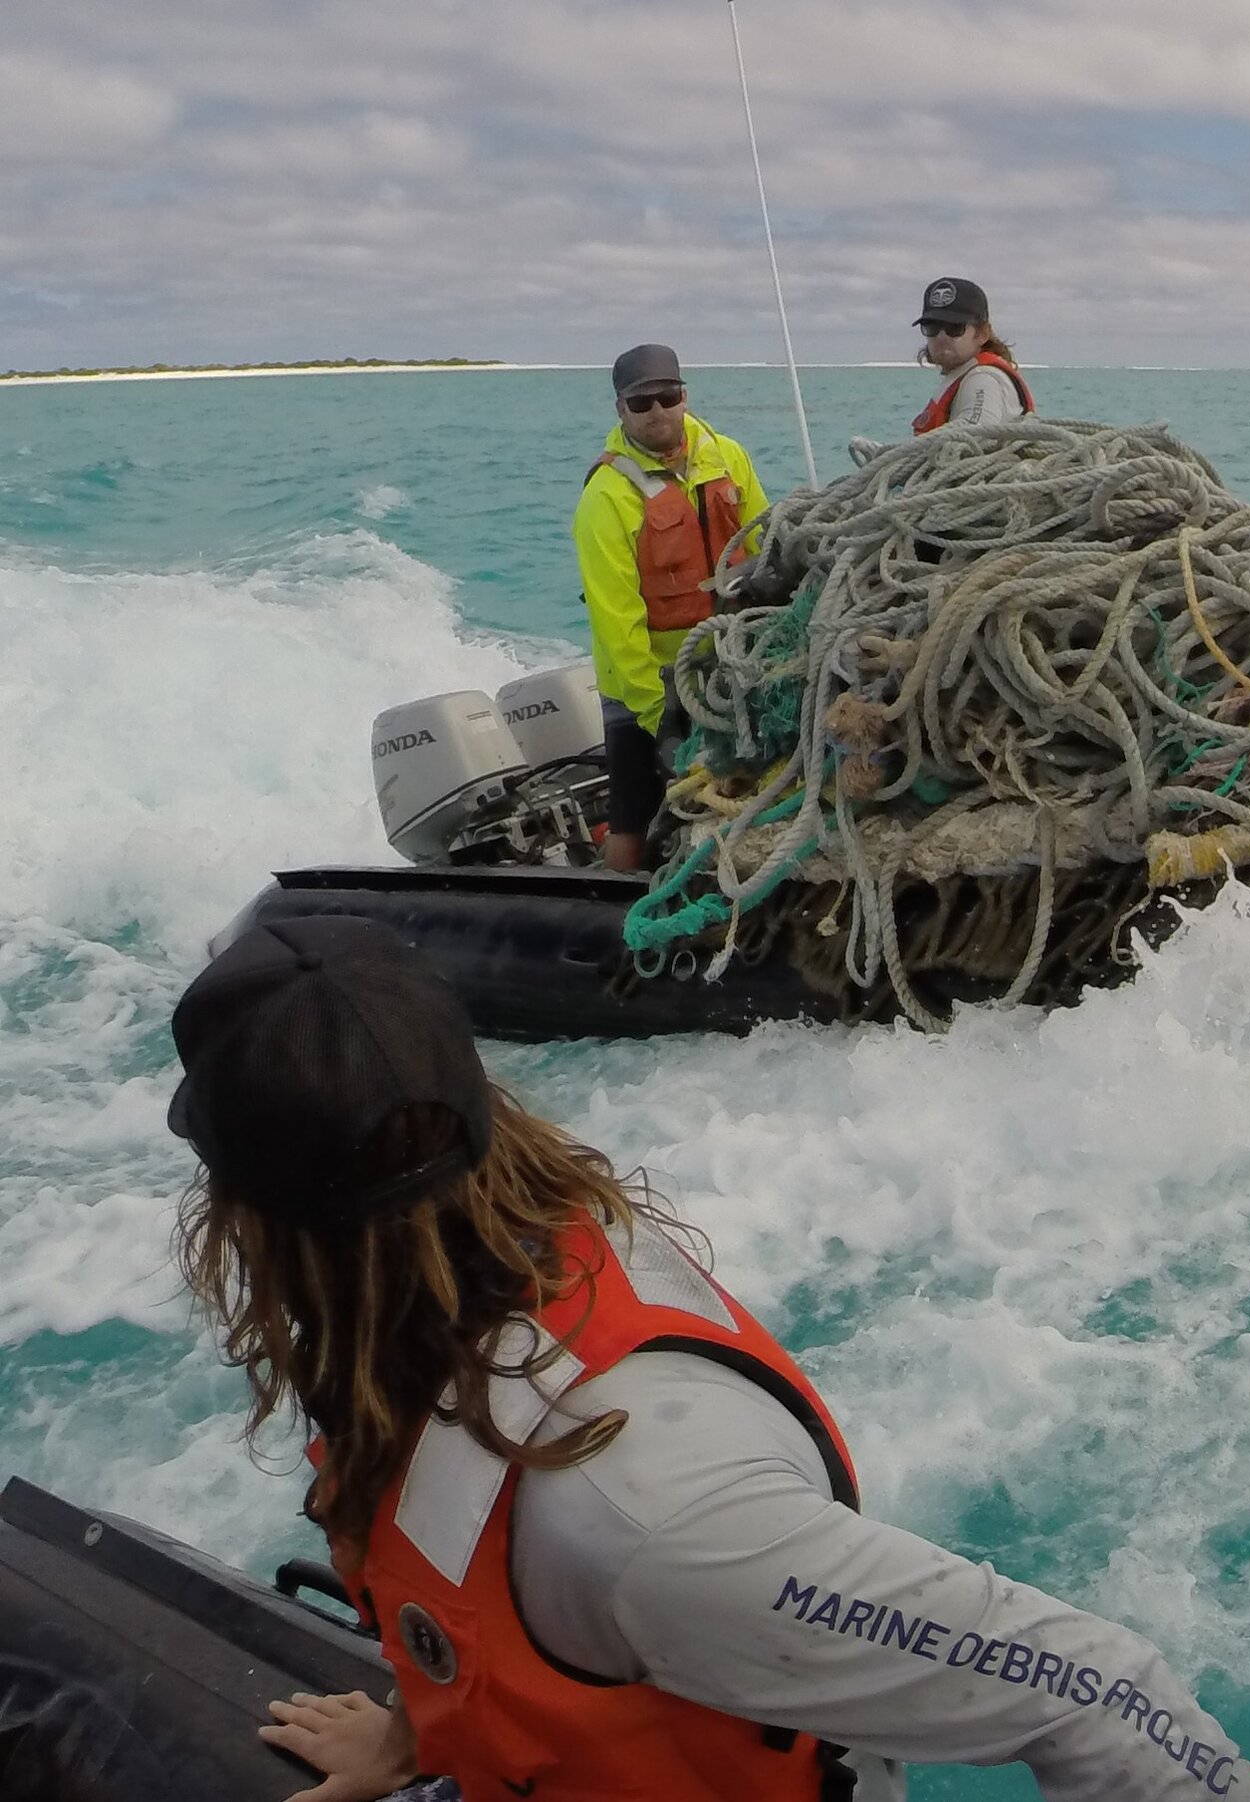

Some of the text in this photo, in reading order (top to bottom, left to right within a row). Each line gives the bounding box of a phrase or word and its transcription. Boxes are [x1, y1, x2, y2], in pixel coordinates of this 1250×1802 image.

[772, 1575, 1238, 1796] MARINE DEBRIS PROJEC
